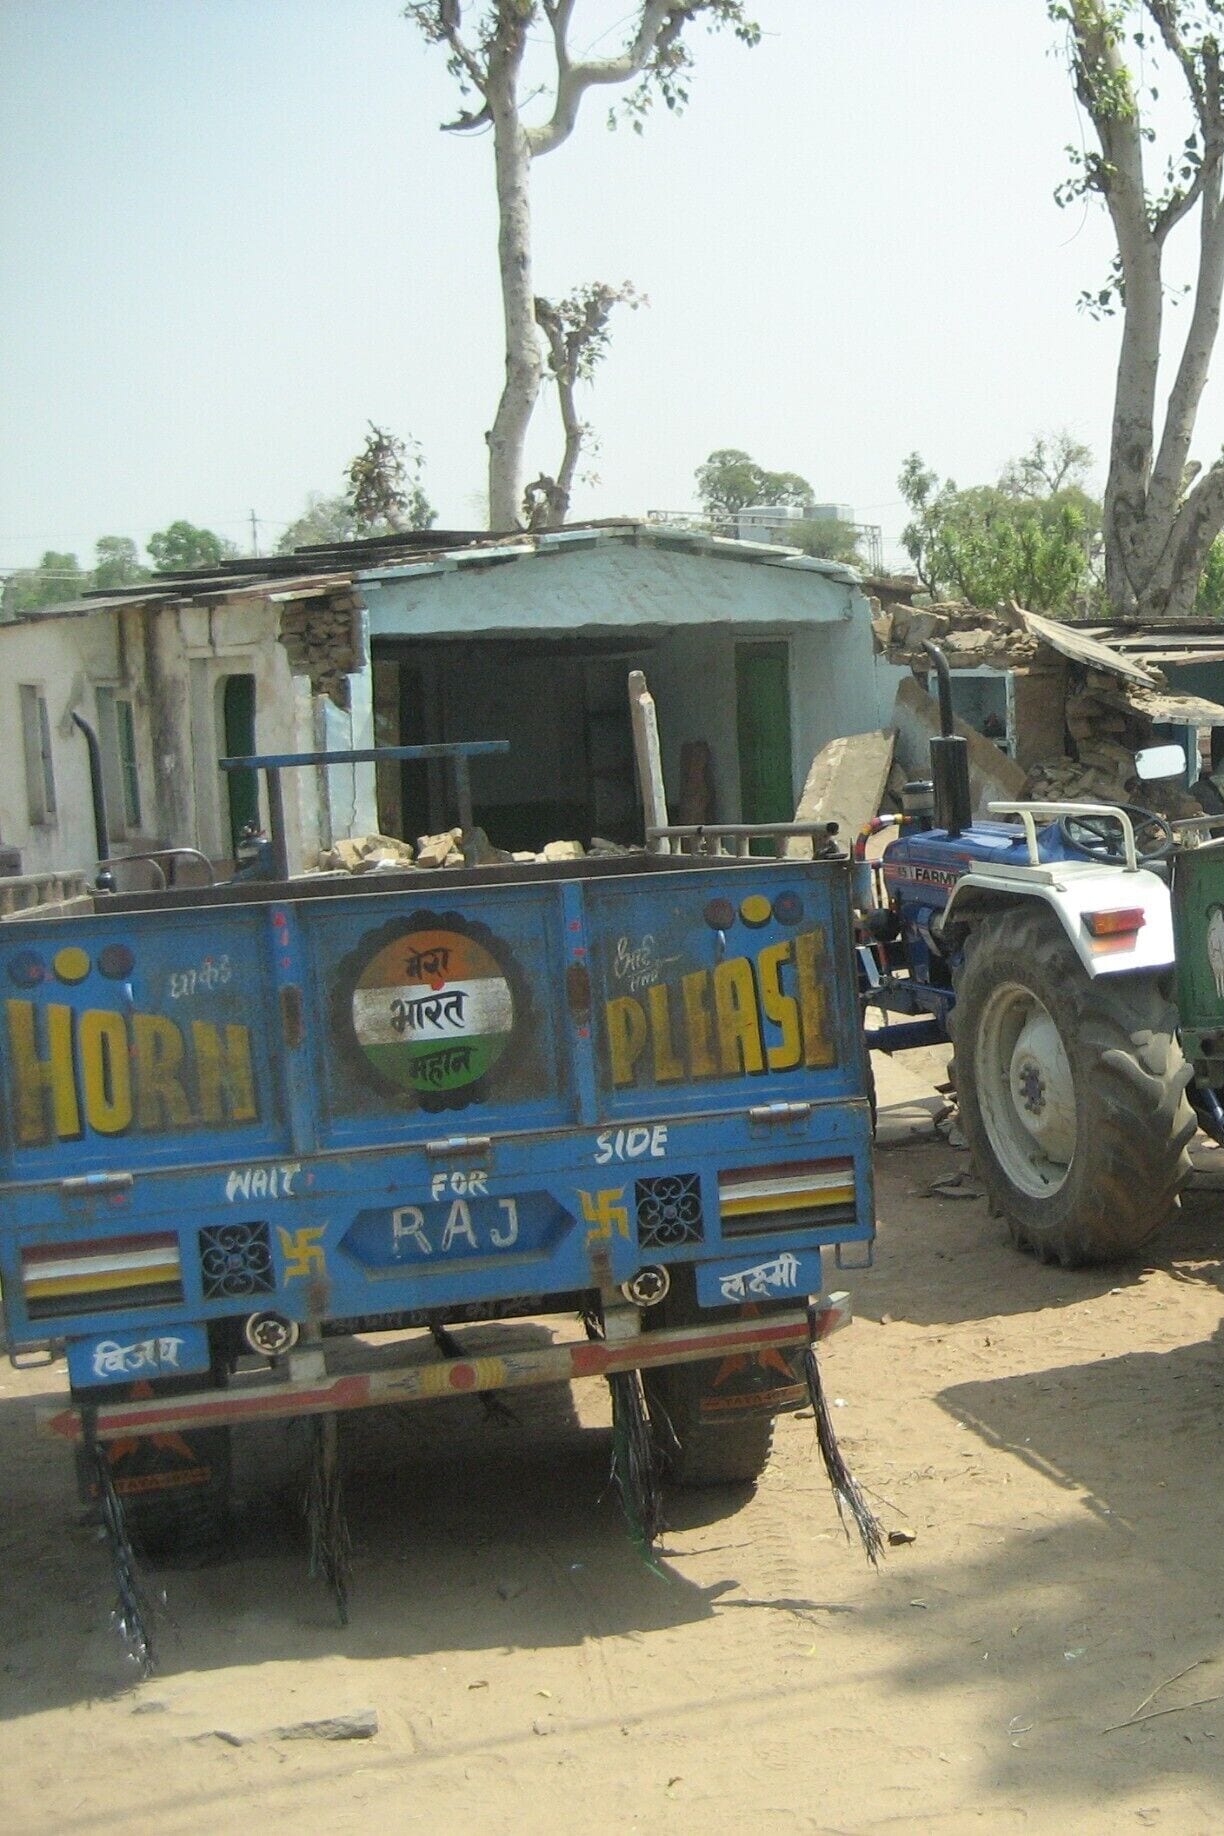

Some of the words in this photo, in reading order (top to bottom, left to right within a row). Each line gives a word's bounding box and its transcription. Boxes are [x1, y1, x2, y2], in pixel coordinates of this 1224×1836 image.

[405, 946, 451, 979] मेरा
[389, 990, 470, 1035] भारत
[605, 922, 838, 1089] PLEASE
[7, 998, 259, 1148] HORN
[407, 1045, 480, 1088] महान
[225, 1163, 301, 1201] WAIT
[431, 1170, 489, 1201] FOR
[594, 1124, 669, 1164] SIDE
[392, 1199, 519, 1259] RAJ
[719, 1252, 803, 1301] लक्ष्मी
[93, 1337, 186, 1377] विजय
